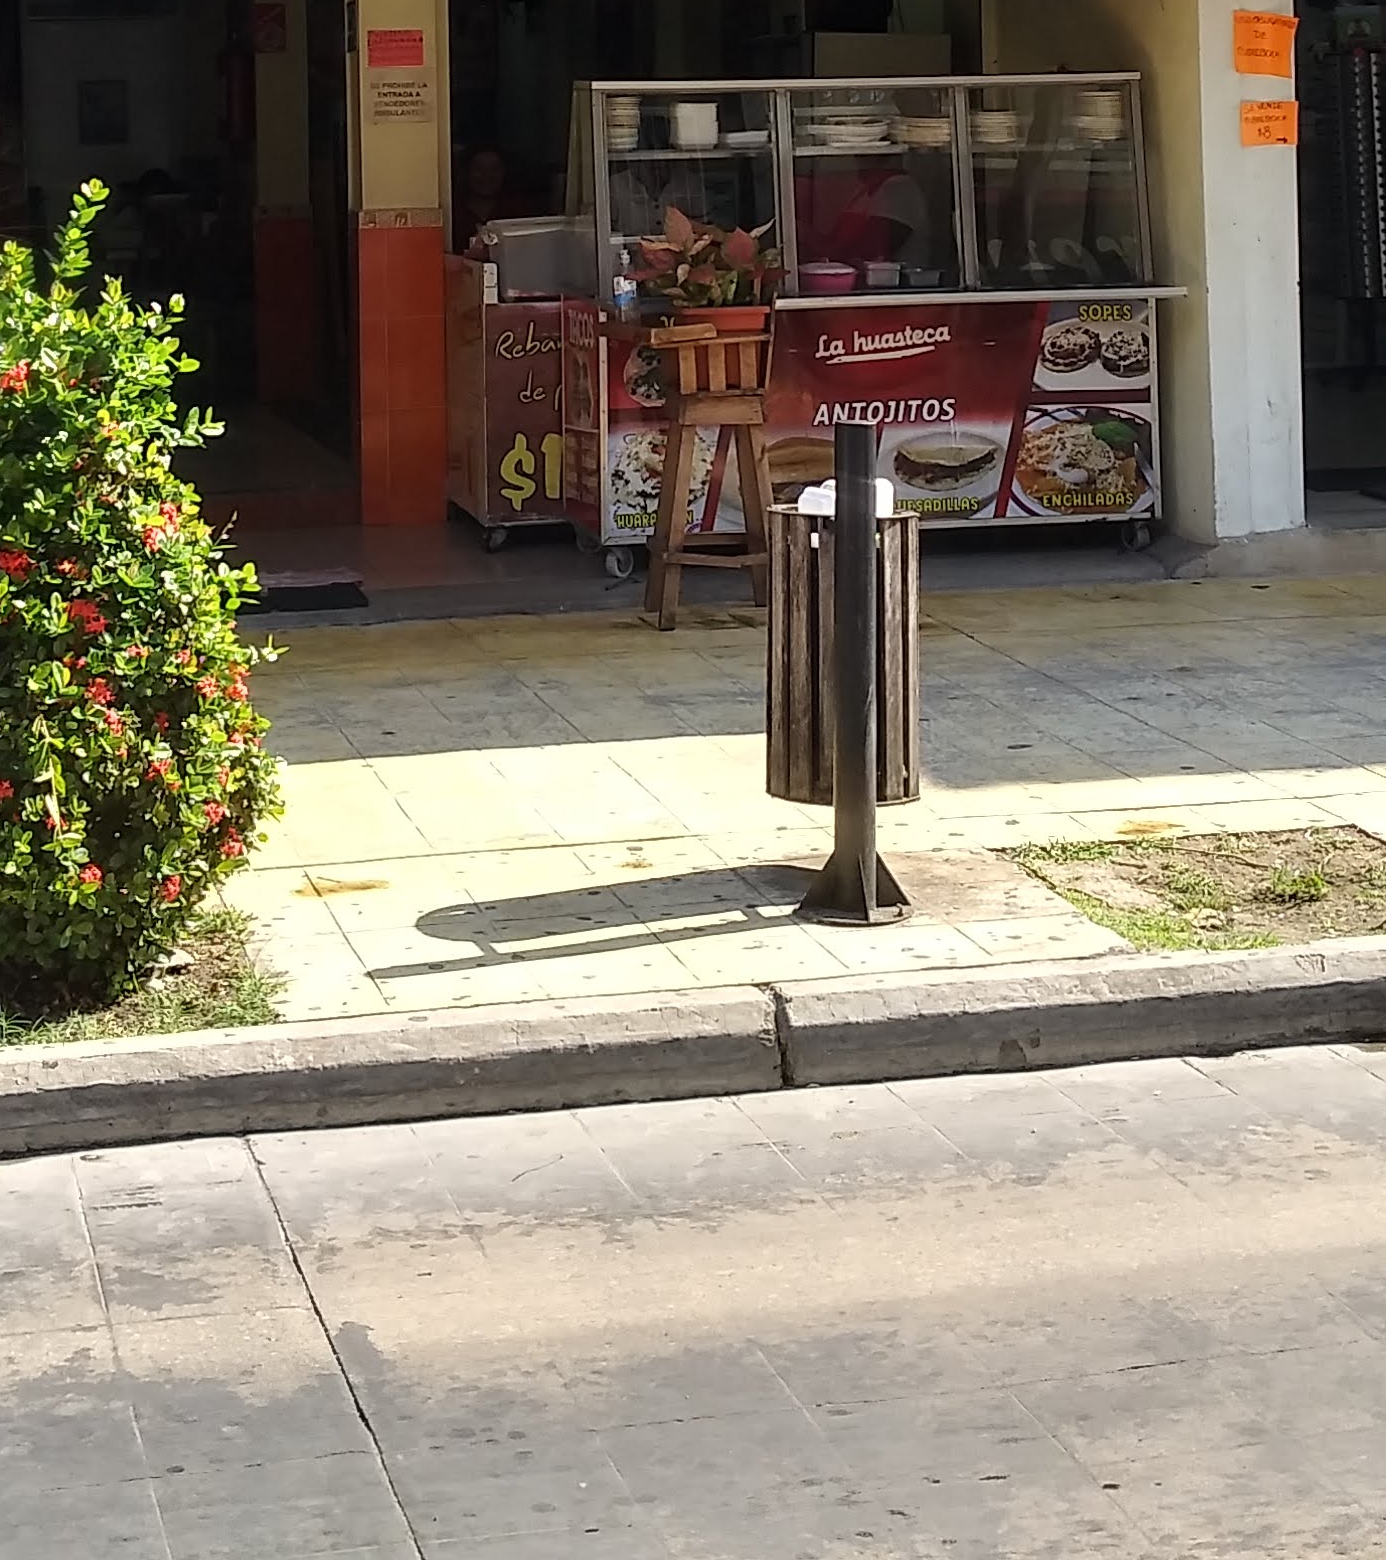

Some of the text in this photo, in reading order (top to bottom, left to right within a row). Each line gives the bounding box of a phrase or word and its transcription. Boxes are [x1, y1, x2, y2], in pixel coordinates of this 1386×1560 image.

[1078, 304, 1133, 322] SOPES
[815, 325, 951, 359] La huasteca
[519, 370, 546, 404] de
[813, 398, 956, 426] ANTOJITOS
[895, 497, 979, 513] UESADILLAS
[1043, 493, 1134, 508] ENCHILADAS
